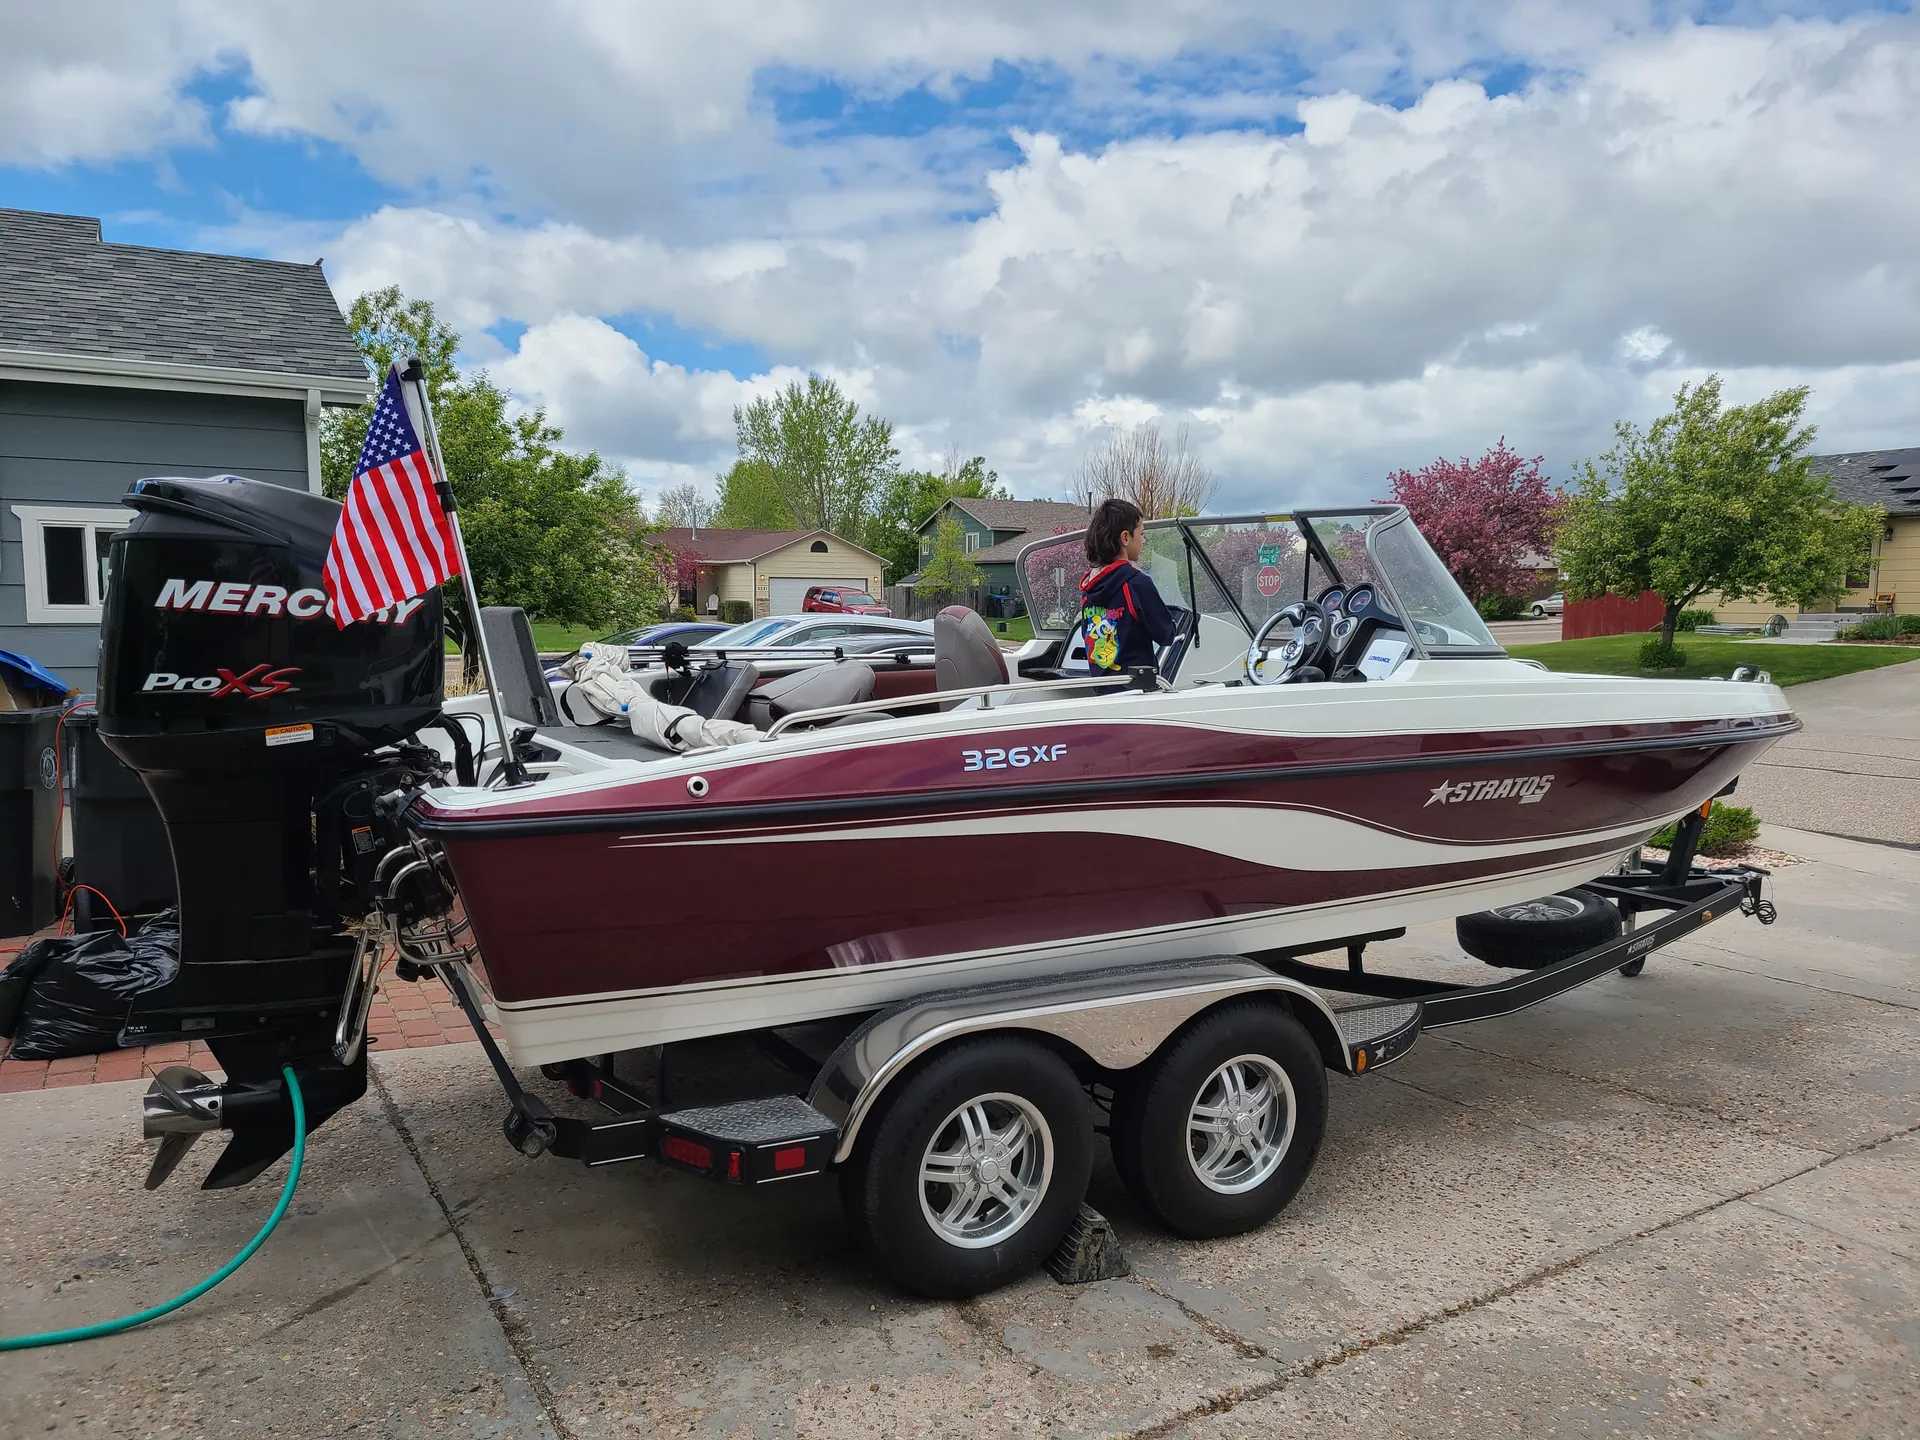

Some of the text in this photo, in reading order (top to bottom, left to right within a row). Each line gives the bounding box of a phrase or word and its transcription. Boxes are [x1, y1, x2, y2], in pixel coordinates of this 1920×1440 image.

[1259, 575, 1280, 587] STOP
[154, 579, 425, 626] MERCY
[962, 744, 1067, 772] 326XF
[1449, 775, 1555, 802] STRATOS
